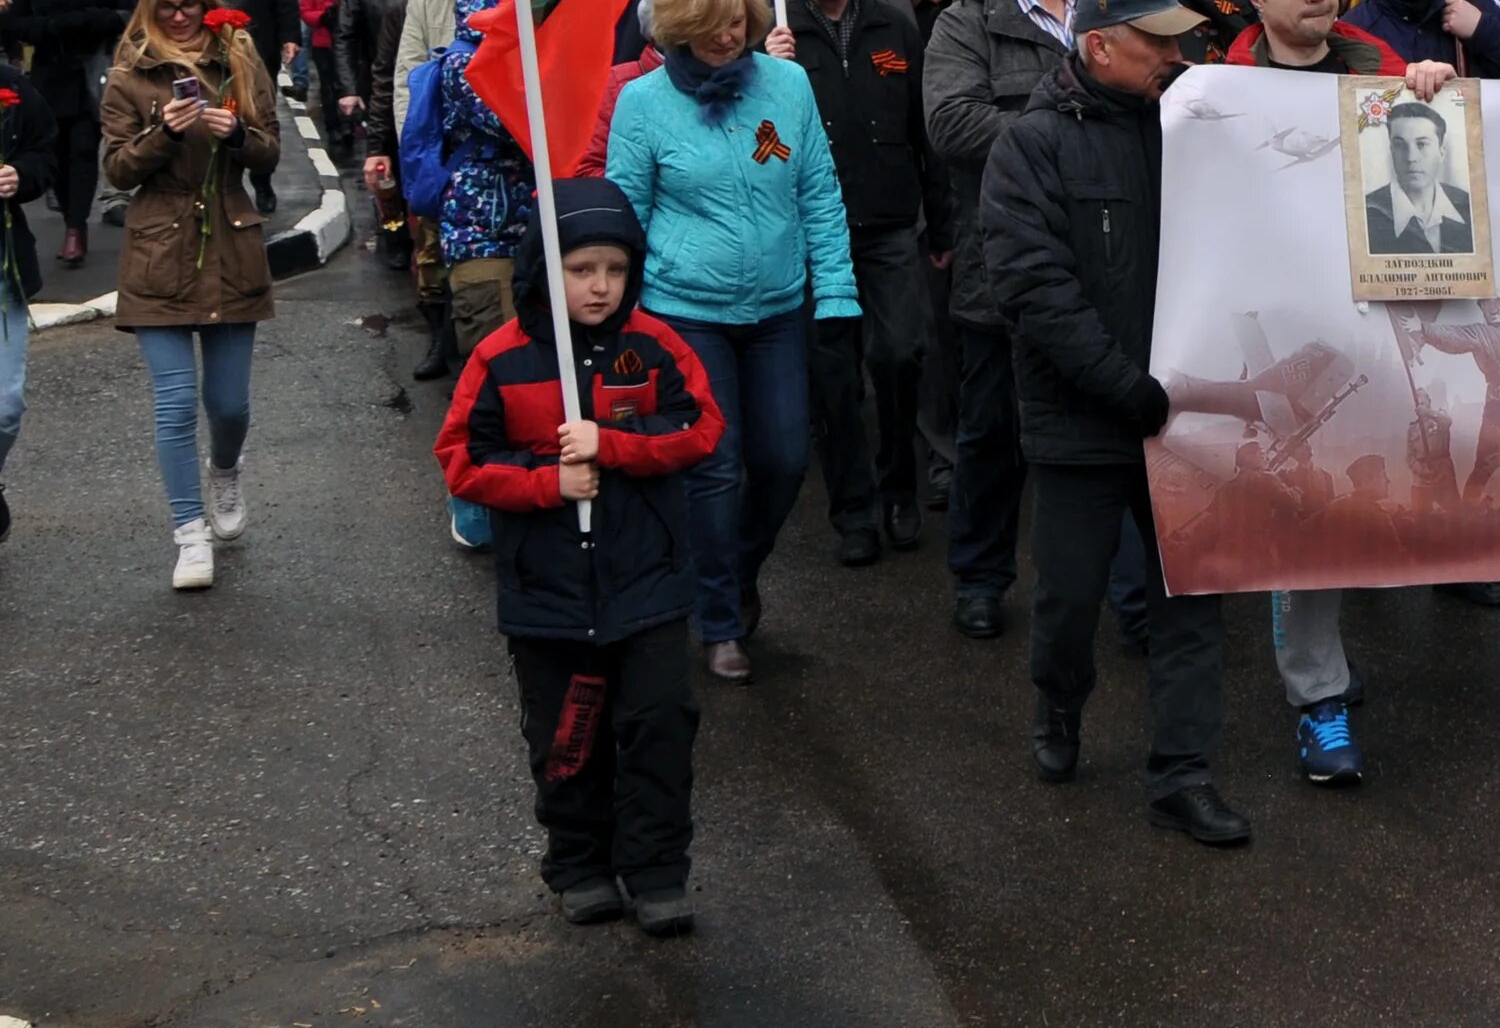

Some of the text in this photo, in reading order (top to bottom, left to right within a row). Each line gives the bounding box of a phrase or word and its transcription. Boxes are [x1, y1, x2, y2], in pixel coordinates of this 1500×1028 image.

[1384, 259, 1454, 269] ЗАГВОЗДКИН
[1359, 271, 1487, 284] ВЛАДИМИР АНТОНОВИЧ
